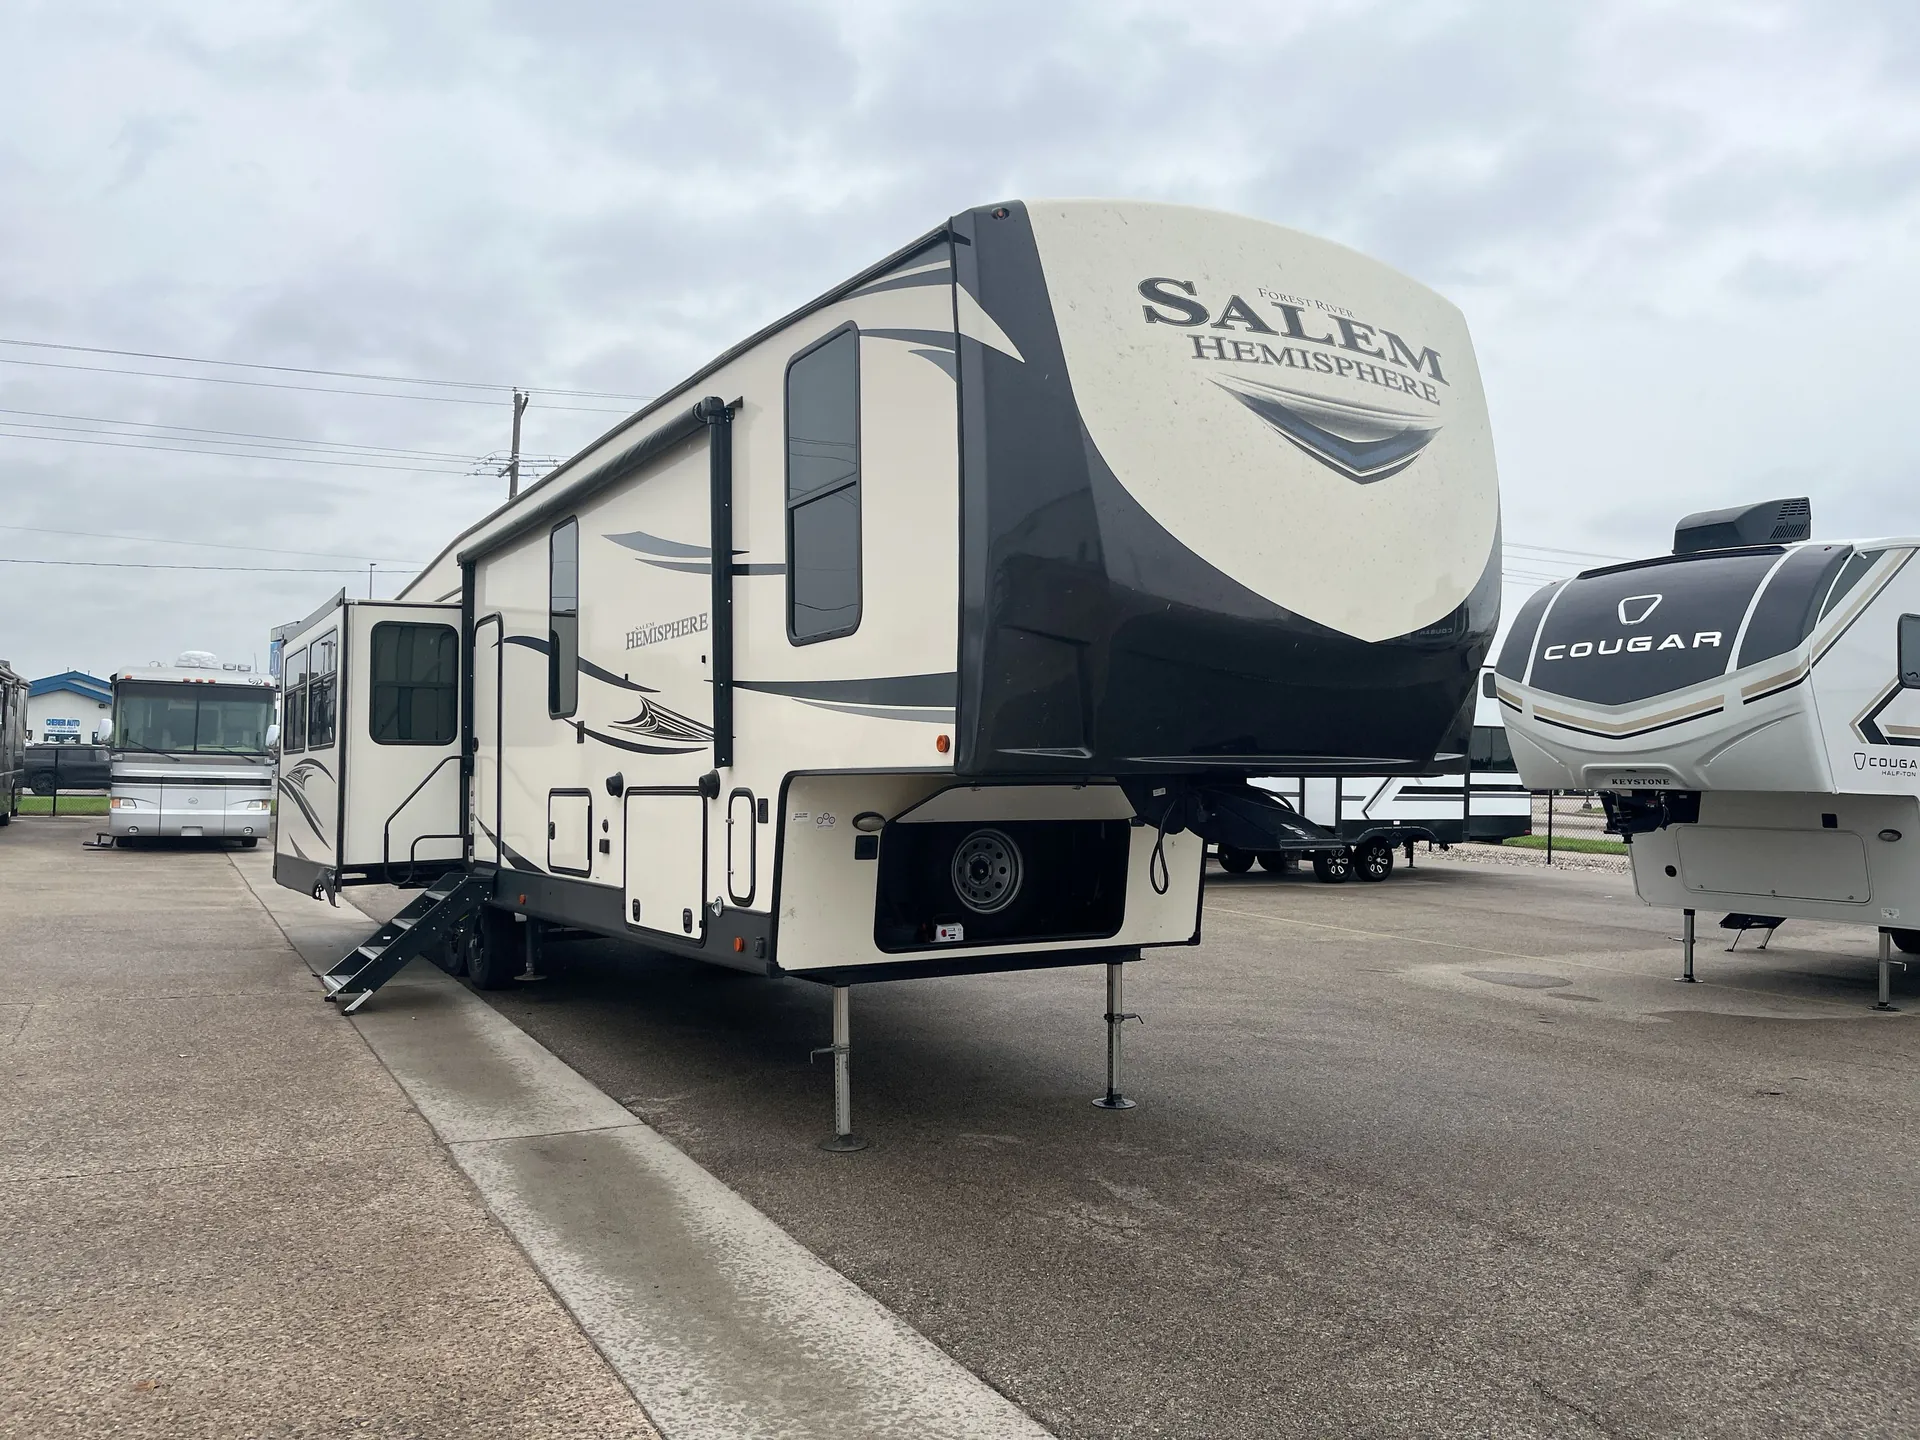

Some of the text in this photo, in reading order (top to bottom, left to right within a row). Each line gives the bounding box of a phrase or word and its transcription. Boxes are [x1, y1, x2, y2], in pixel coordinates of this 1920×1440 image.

[1137, 276, 1450, 387] SALEM
[1186, 334, 1441, 406] HEMISPHERE
[625, 612, 708, 650] HEMISPHERE
[635, 622, 655, 631] SALEM
[1543, 631, 1722, 661] COUGAR
[1611, 778, 1670, 786] KEYSTONE
